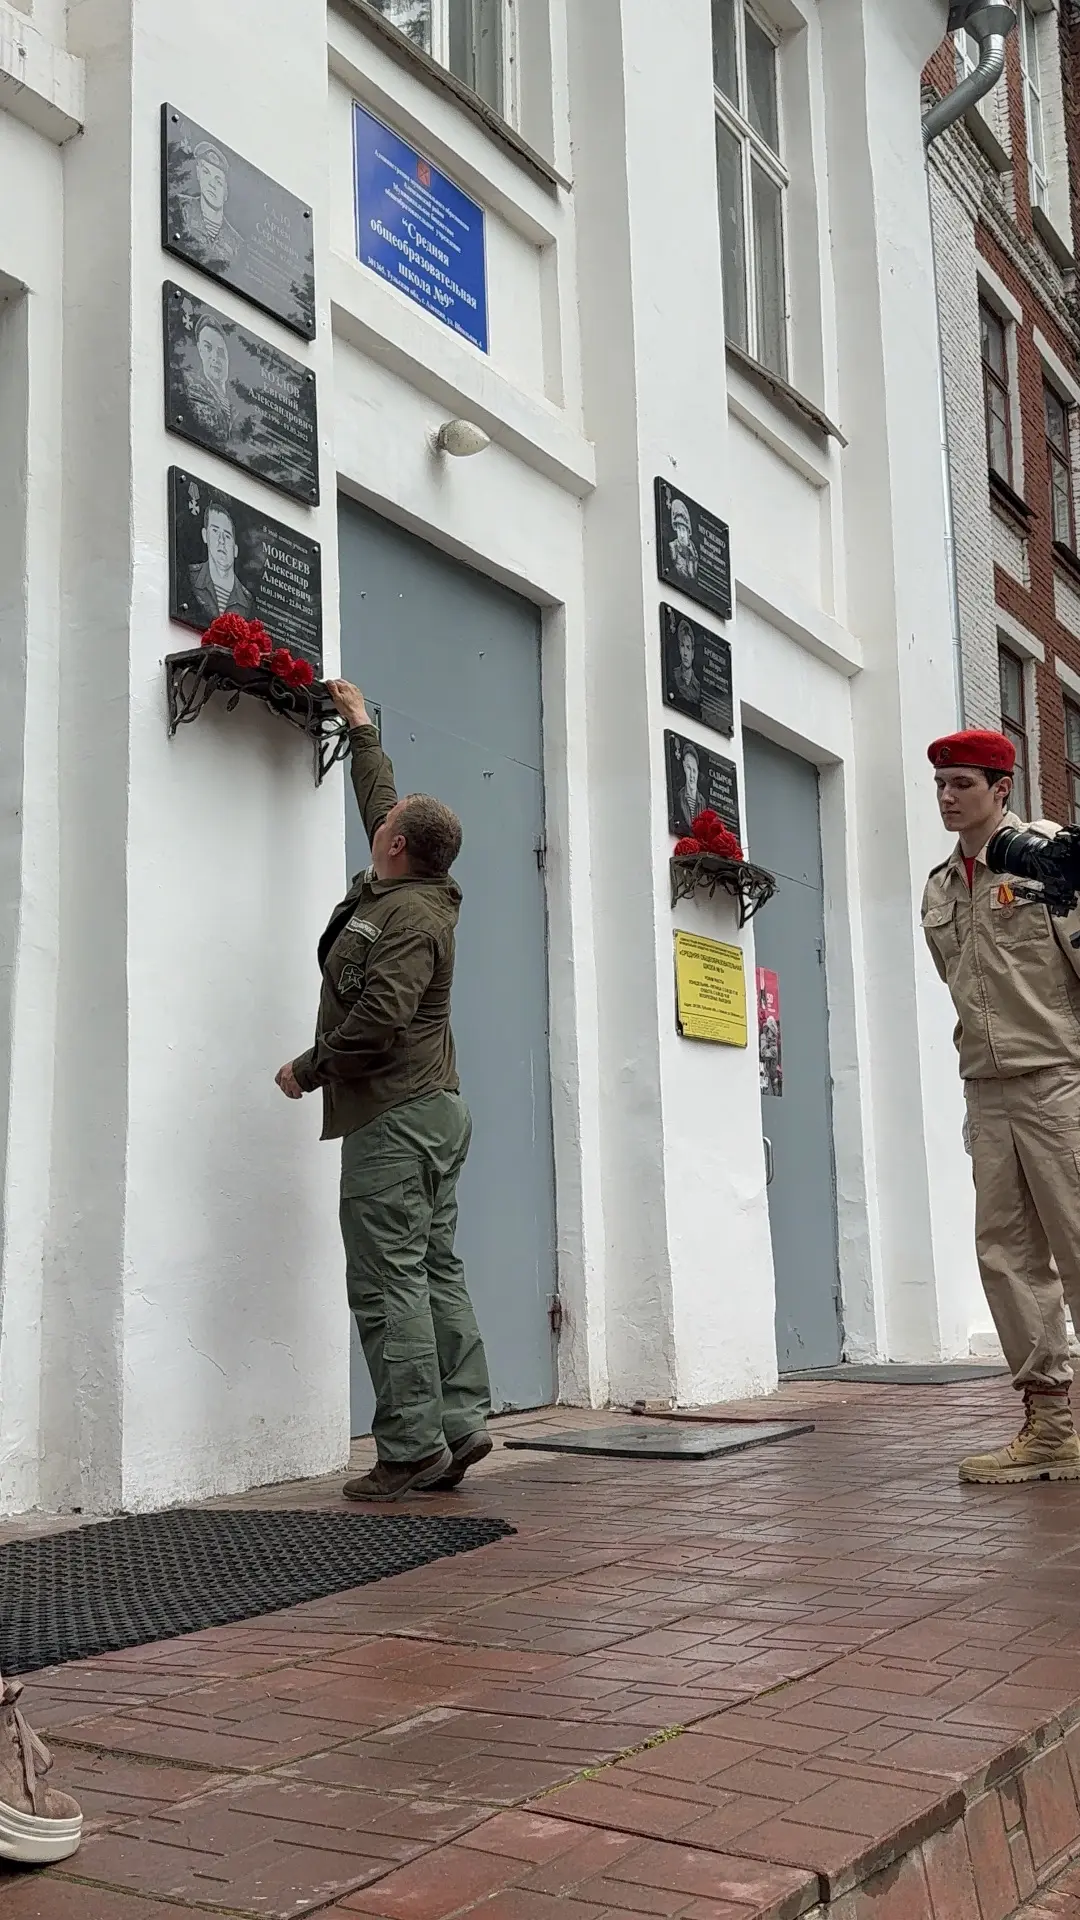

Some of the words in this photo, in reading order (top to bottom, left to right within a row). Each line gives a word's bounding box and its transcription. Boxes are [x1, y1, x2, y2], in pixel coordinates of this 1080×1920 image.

[370, 219, 477, 310] общеобразовательная
[398, 261, 432, 296] школа
[261, 367, 300, 399] КОЗЛОВ
[263, 381, 299, 411] Евгений
[248, 387, 313, 433] Александрович
[262, 541, 310, 575] МОИСЕЕВ
[264, 558, 309, 590] Александр
[262, 570, 311, 603] Алексеевич
